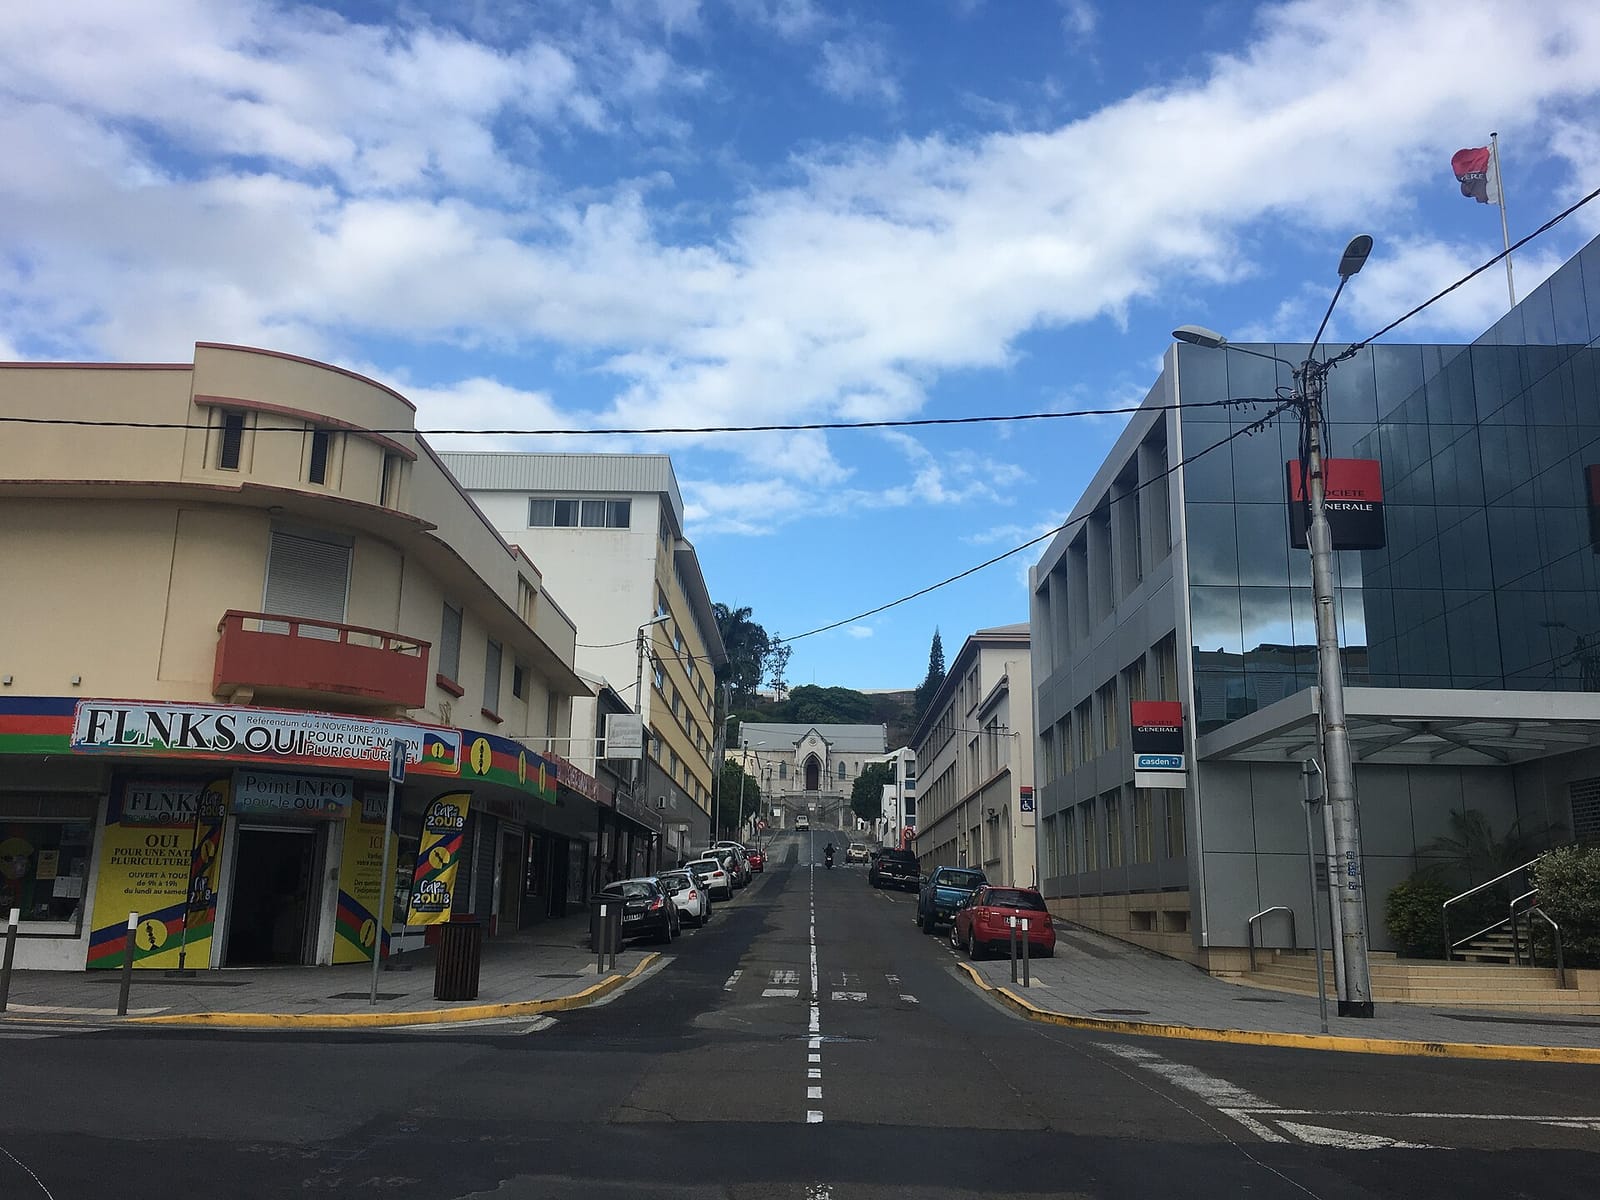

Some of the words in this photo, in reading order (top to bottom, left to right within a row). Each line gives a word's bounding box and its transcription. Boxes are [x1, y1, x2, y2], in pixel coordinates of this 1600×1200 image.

[1325, 489, 1365, 497] OCIETE
[1308, 503, 1374, 511] NERALE
[82, 709, 237, 750] FLNKS
[246, 716, 299, 728] Référendum
[321, 722, 369, 733] NOVEMBRE
[370, 727, 390, 735] 2018
[245, 727, 305, 754] OUI
[307, 731, 345, 744] POUR
[347, 734, 373, 746] UNE
[377, 737, 419, 750] NAON
[306, 744, 412, 763] PLURICULTUREE
[1141, 757, 1170, 766] casden
[246, 776, 291, 794] Point
[295, 780, 346, 798] INFO
[243, 798, 274, 809] pour
[279, 796, 290, 808] le
[294, 798, 320, 810] OUI
[434, 803, 454, 818] Cap
[145, 834, 180, 847] OUI
[114, 848, 142, 856] POUR
[145, 849, 166, 857] UNE
[111, 857, 191, 866] PLURICULTURE
[421, 880, 441, 895] Cap
